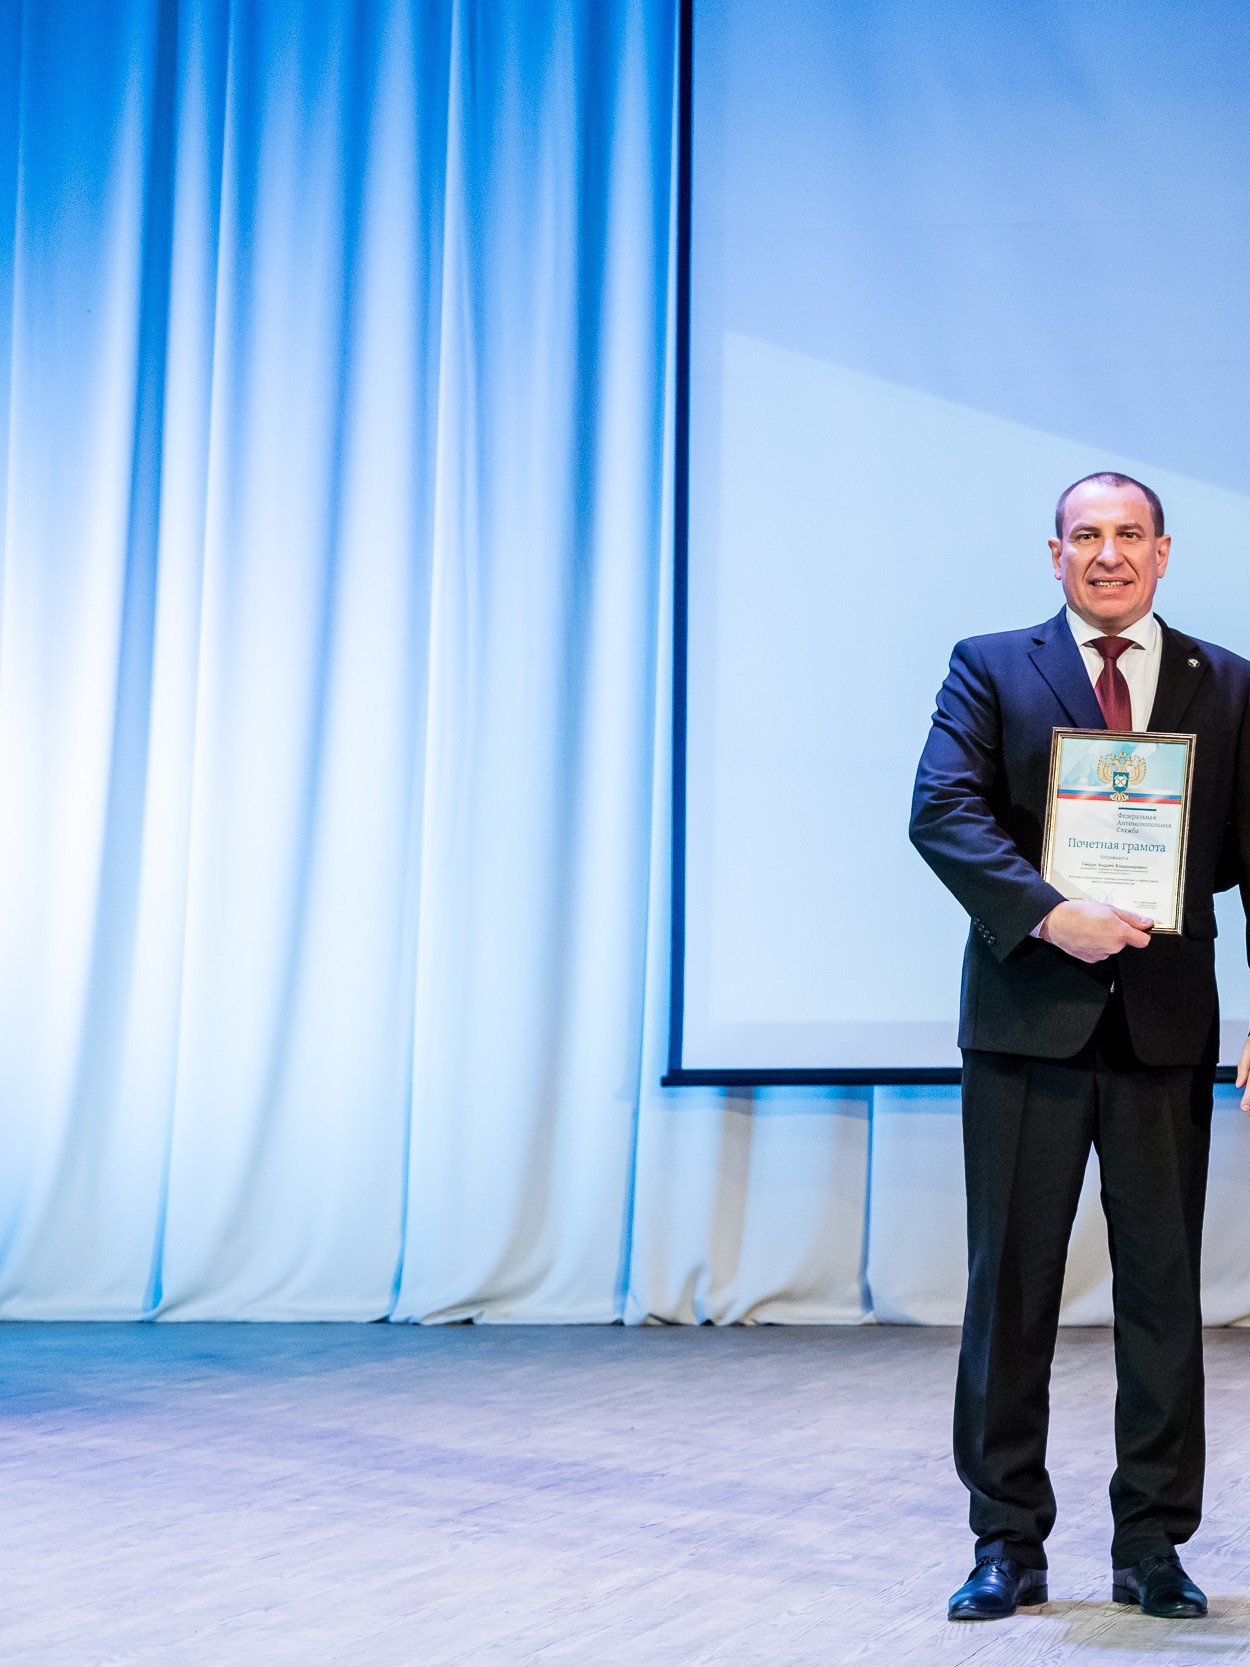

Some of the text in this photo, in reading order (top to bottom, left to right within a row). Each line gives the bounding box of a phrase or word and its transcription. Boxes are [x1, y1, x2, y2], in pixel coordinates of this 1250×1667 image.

[1117, 812, 1157, 821] Федеральная
[1116, 827, 1139, 835] Служба
[1068, 837, 1166, 854] Почетная грамота
